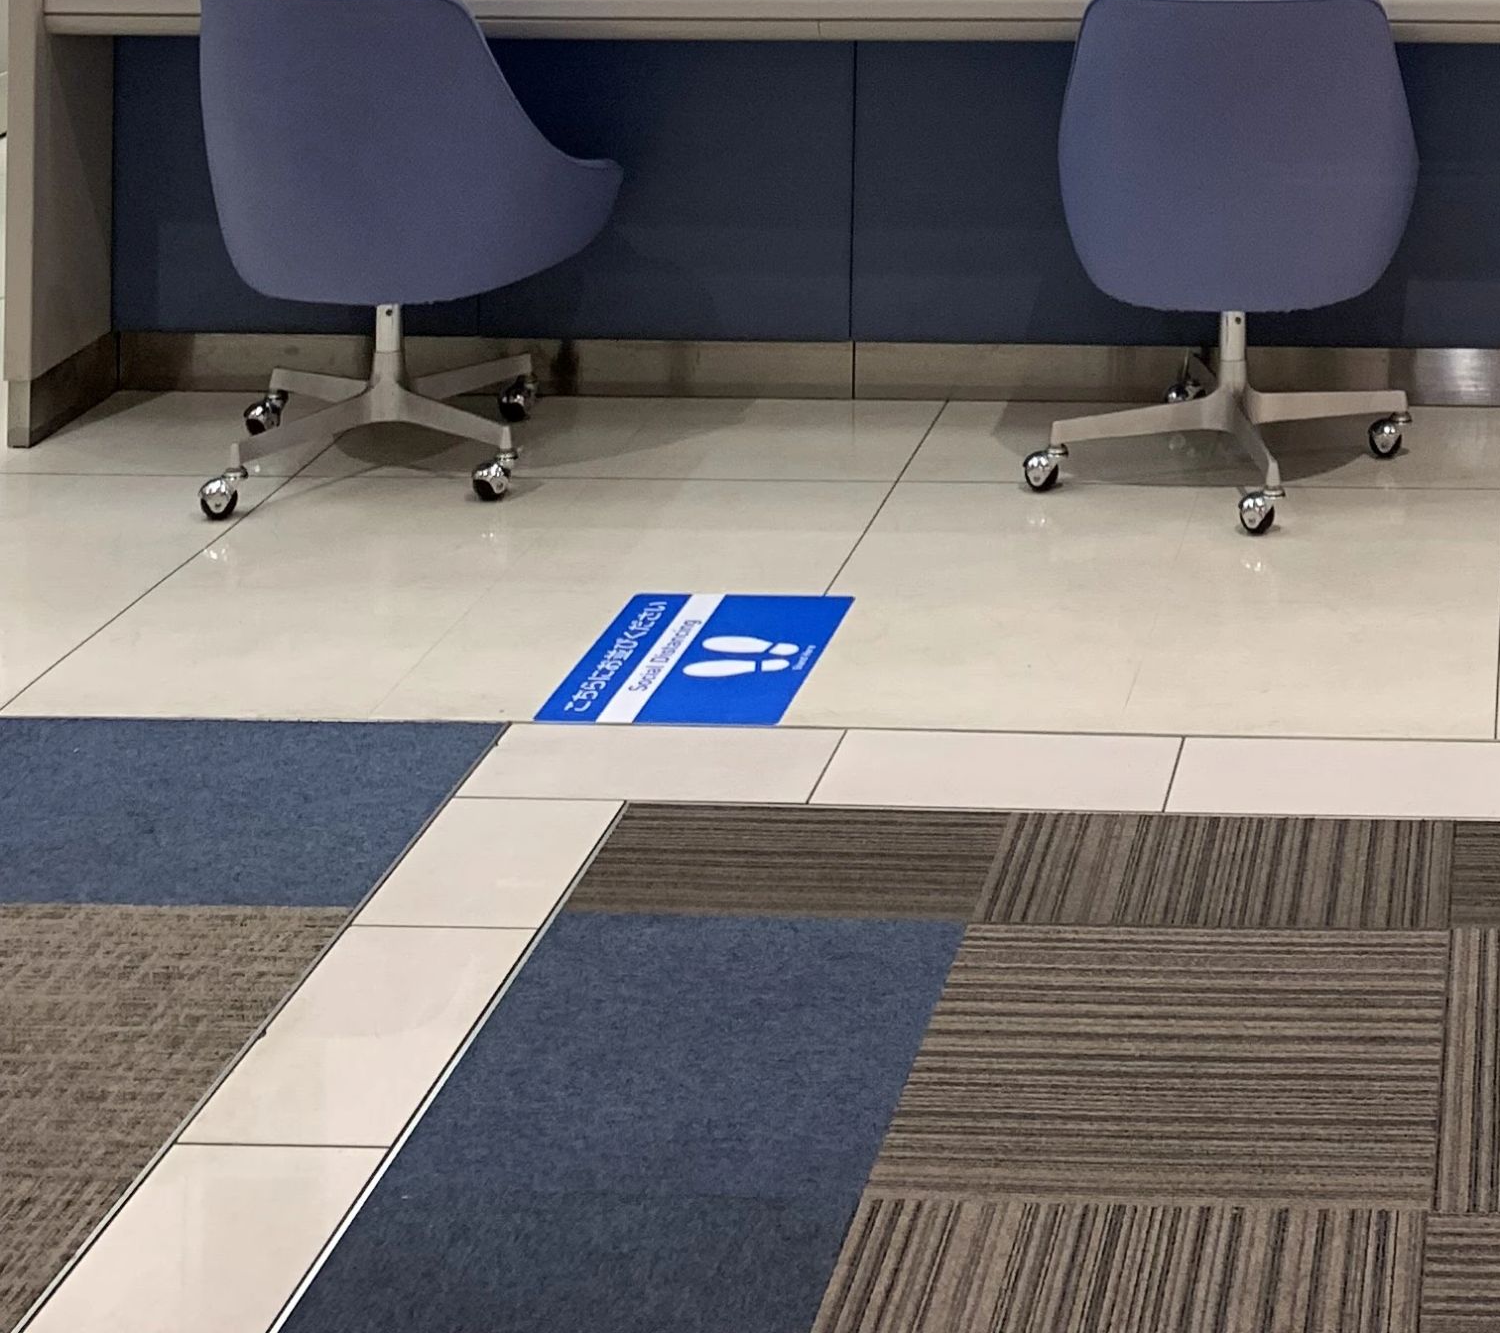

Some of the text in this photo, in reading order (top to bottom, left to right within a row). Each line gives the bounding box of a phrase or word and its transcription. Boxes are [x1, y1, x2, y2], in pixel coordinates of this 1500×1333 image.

[564, 601, 668, 713] こちらにお並びください
[628, 620, 702, 692] Social Distancing
